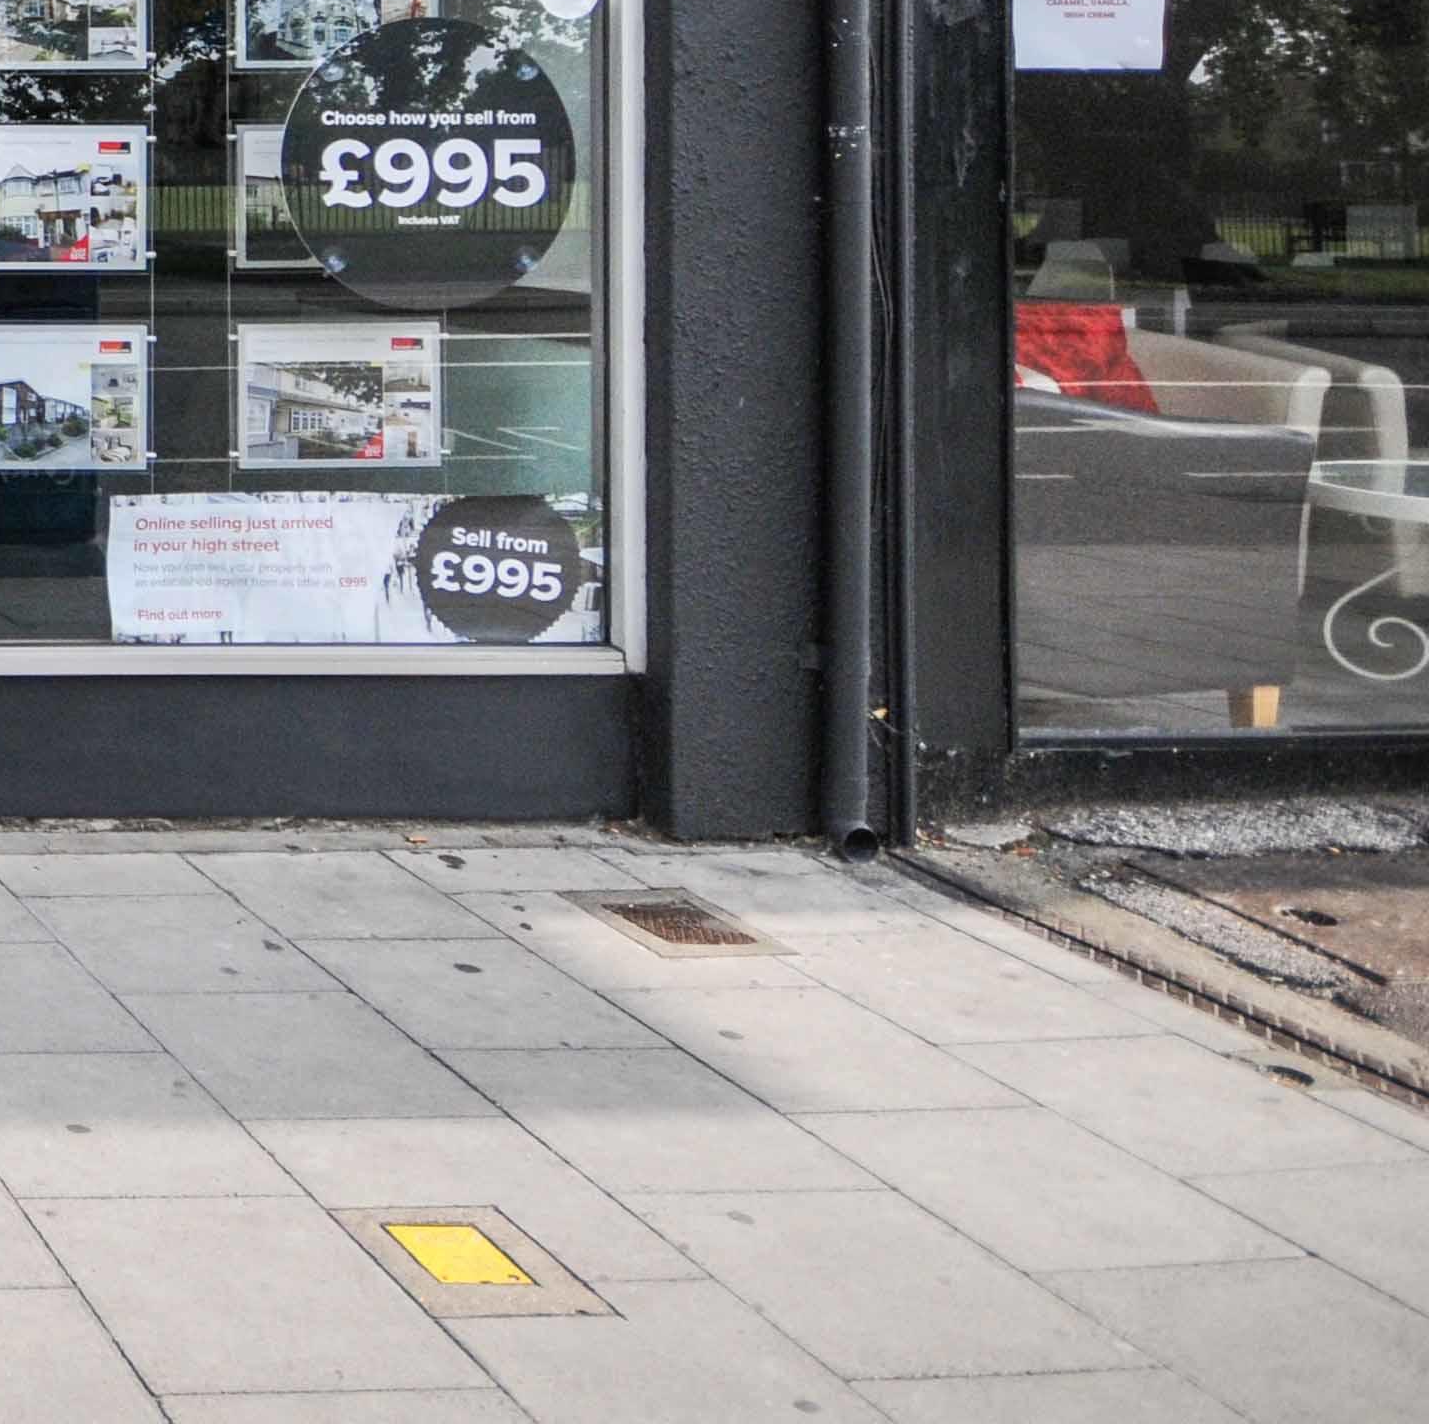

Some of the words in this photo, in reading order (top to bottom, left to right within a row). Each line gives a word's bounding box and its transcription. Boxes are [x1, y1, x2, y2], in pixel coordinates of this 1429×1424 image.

[321, 110, 386, 126] Choose
[389, 110, 427, 126] how
[429, 113, 462, 129] you
[464, 110, 493, 126] sell
[496, 110, 536, 126] from
[318, 138, 547, 208] £995
[398, 215, 439, 226] Includes
[440, 215, 461, 226] VAT
[136, 517, 187, 531] Online
[189, 516, 241, 532] selling
[244, 516, 278, 533] just
[281, 515, 334, 530] arrived
[133, 538, 148, 553] in
[153, 541, 187, 555] your
[191, 538, 227, 554] high
[232, 539, 280, 553] street
[451, 527, 492, 548] Sell
[495, 531, 549, 554] from
[338, 576, 368, 588] £995
[430, 551, 563, 602] £995
[137, 609, 165, 621] Find
[168, 609, 189, 621] out
[191, 610, 223, 620] more
